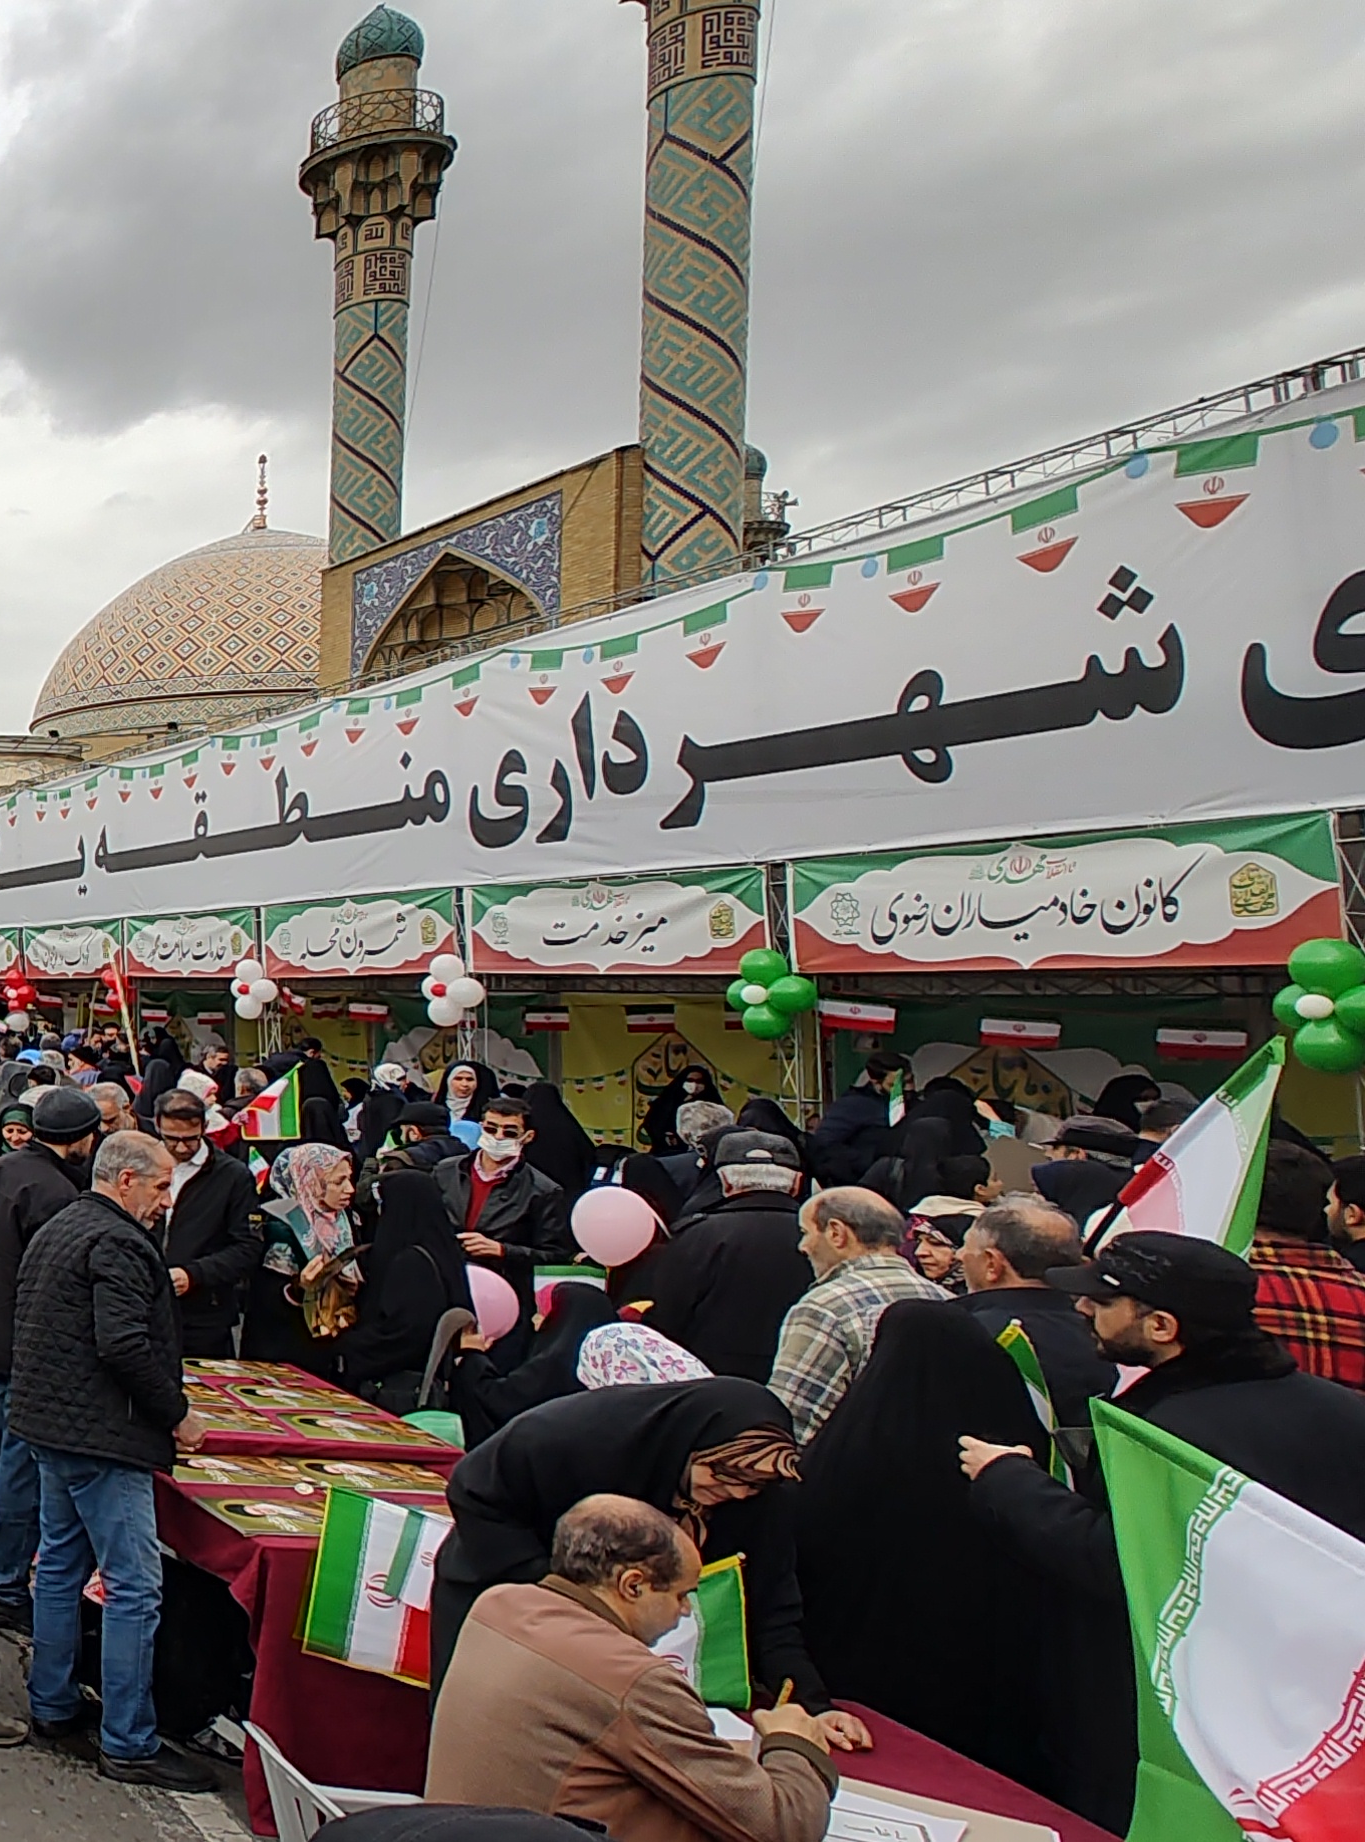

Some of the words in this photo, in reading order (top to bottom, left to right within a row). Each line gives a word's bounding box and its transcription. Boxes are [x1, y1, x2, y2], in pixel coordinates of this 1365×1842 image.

[468, 564, 1186, 850] شهرداری
[93, 751, 451, 874] منطقه
[871, 891, 932, 945] رضوی
[931, 884, 1097, 941] خادمیاران
[1100, 851, 1207, 935] کانون
[300, 927, 340, 961] محله
[542, 914, 629, 947] خدمت
[624, 912, 668, 953] میز
